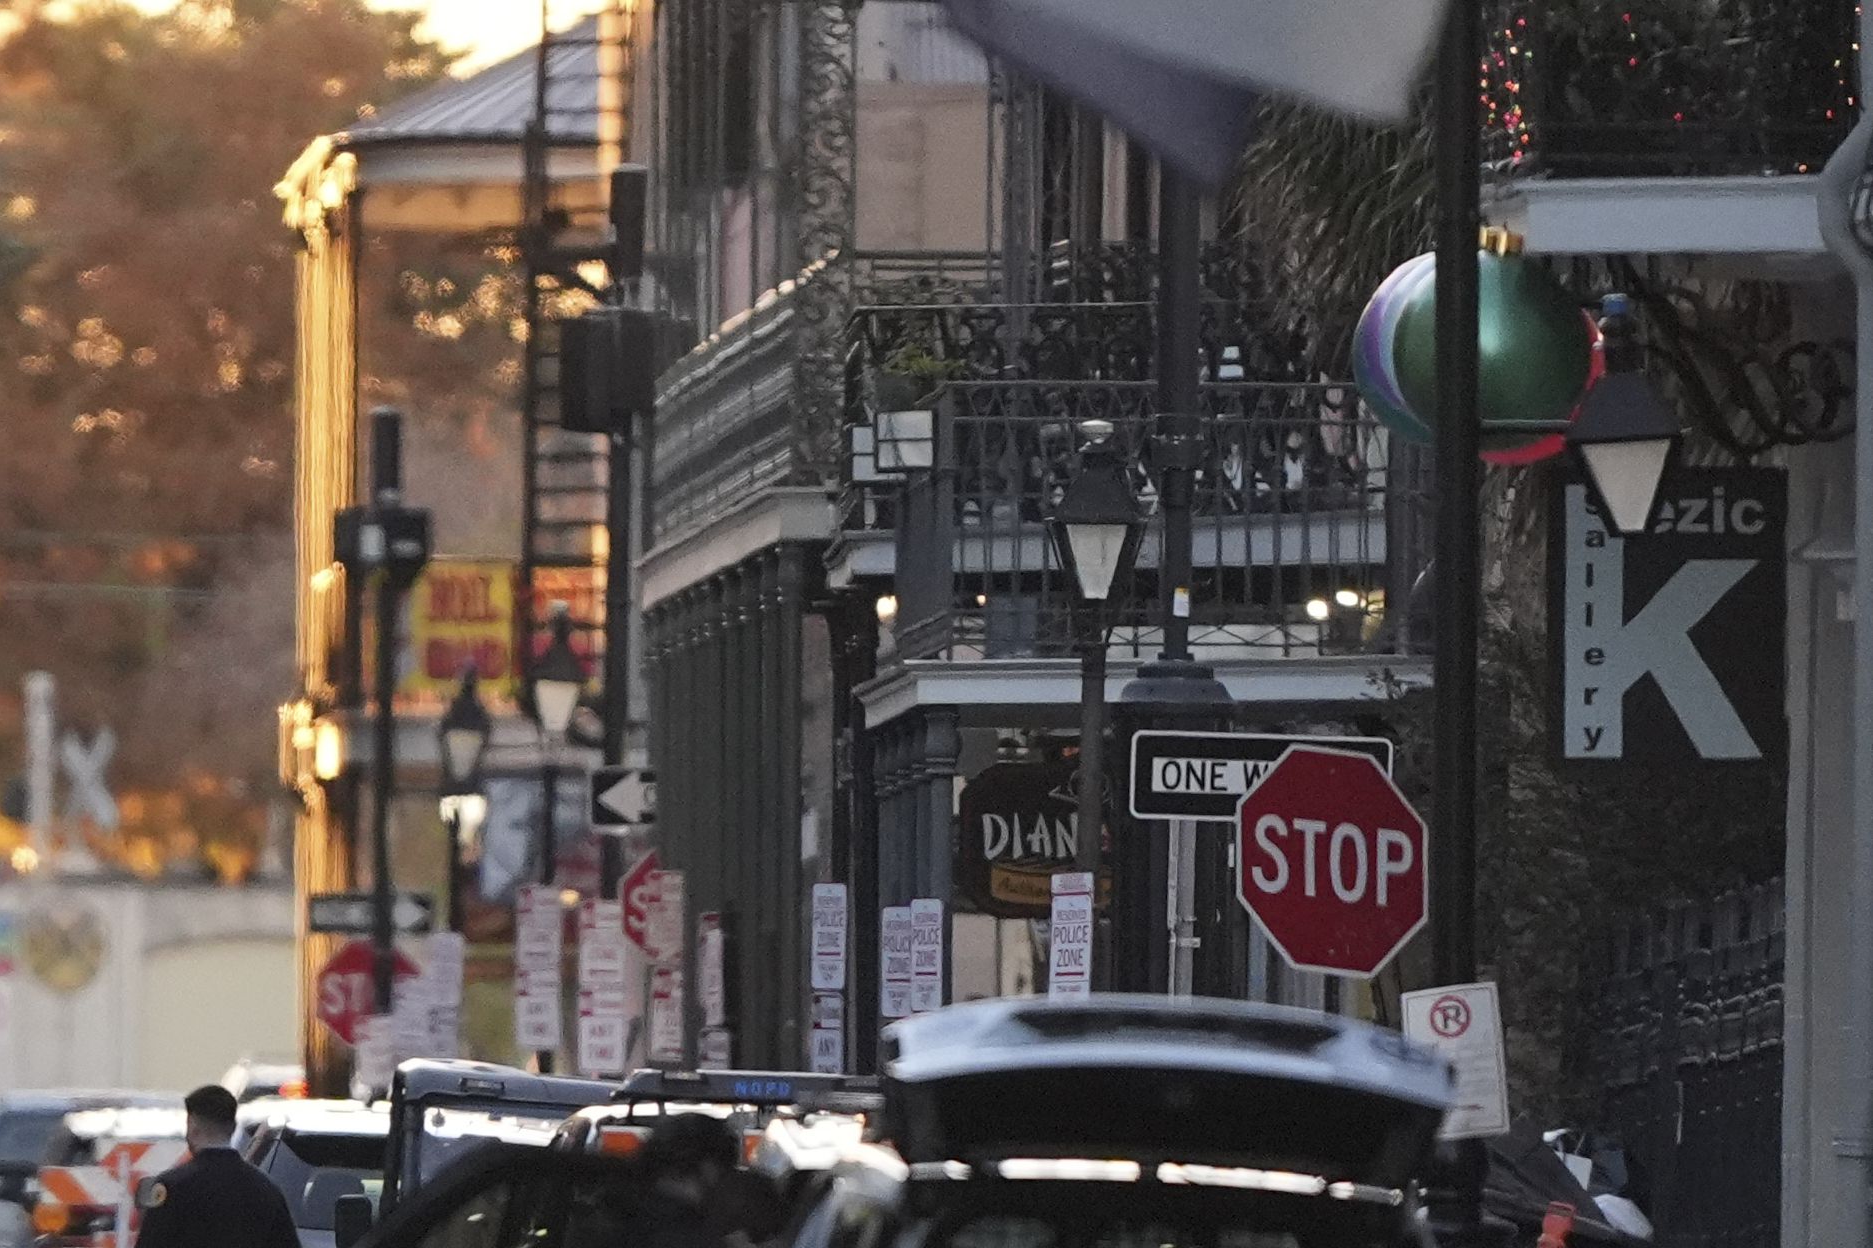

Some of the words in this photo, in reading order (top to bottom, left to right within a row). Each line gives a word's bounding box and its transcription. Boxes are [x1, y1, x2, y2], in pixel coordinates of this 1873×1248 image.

[1654, 486, 1767, 535] ezic
[1583, 503, 1606, 752] allery
[1161, 760, 1227, 791] ONE
[982, 812, 1078, 860] DIAN
[1251, 813, 1414, 907] STOP
[884, 935, 911, 953] POLIC
[913, 927, 940, 945] POLICE
[1053, 925, 1089, 944] POLICE
[915, 950, 936, 967] ZONE
[1056, 949, 1084, 967] ZONE
[323, 972, 367, 1015] ST
[734, 1080, 791, 1097] NOPD
